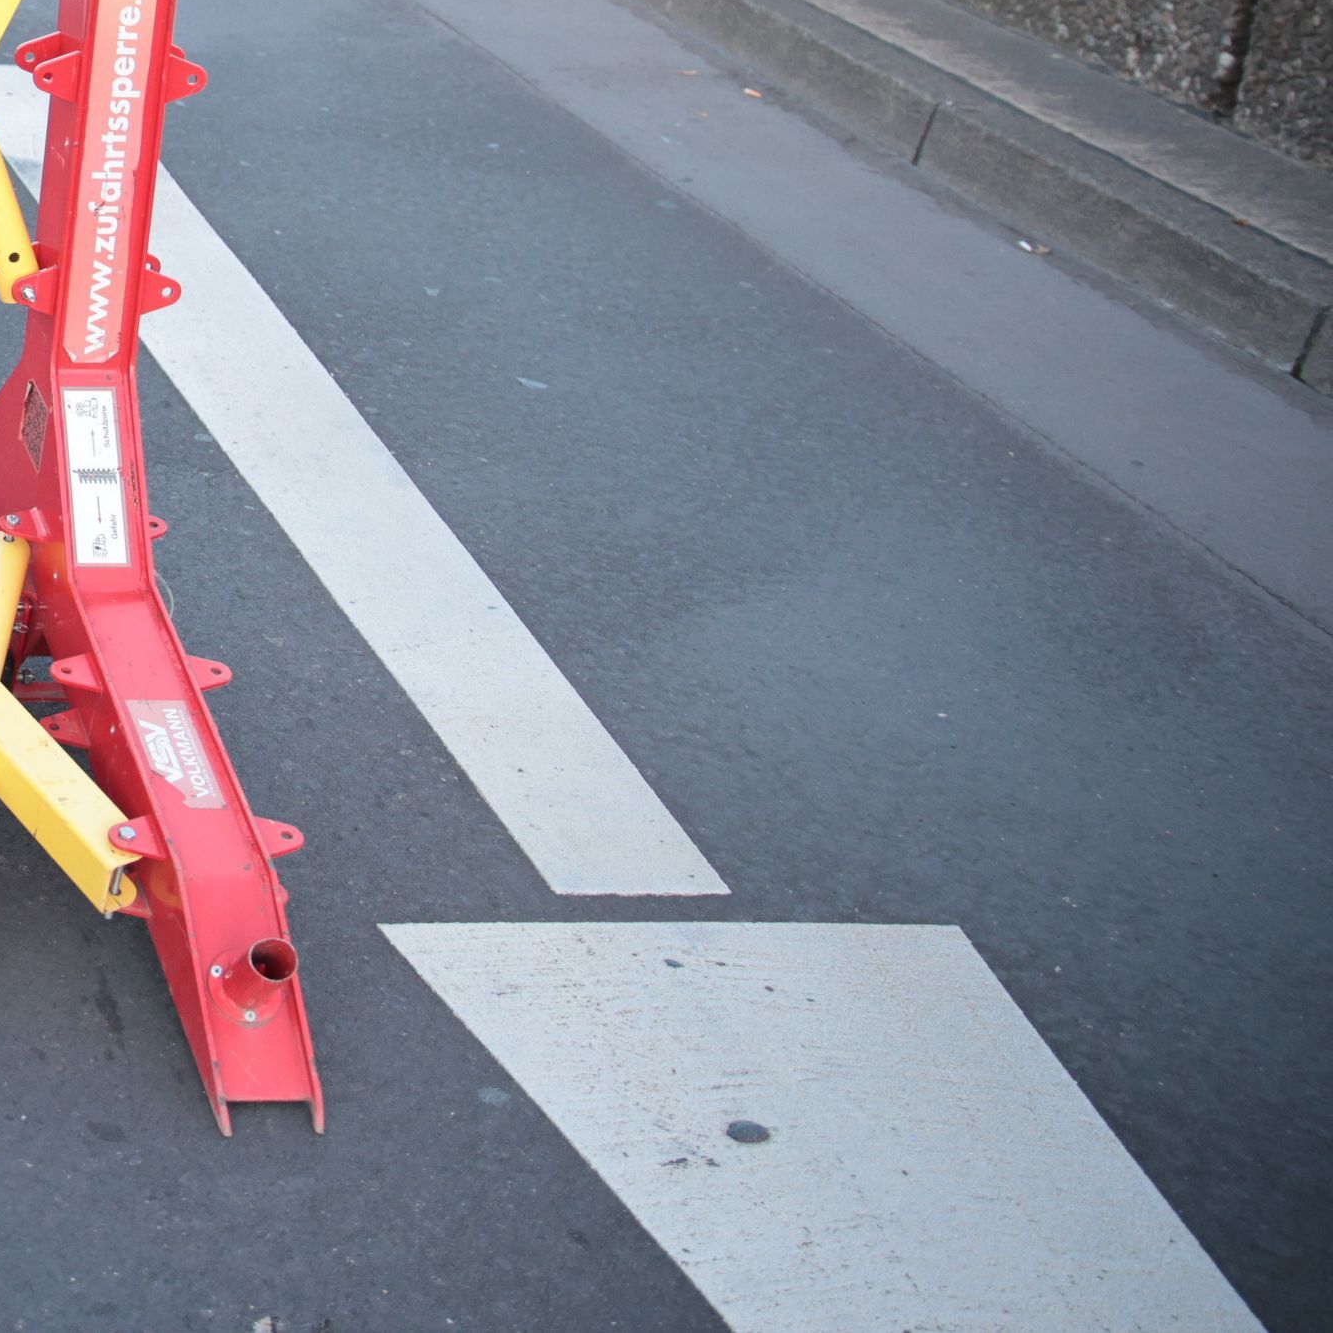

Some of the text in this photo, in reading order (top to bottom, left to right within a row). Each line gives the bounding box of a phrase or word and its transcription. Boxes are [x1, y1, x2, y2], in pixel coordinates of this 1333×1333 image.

[101, 405, 111, 448] Schutzzone
[110, 513, 119, 540] Gefahr
[163, 708, 210, 797] VOLKMANN
